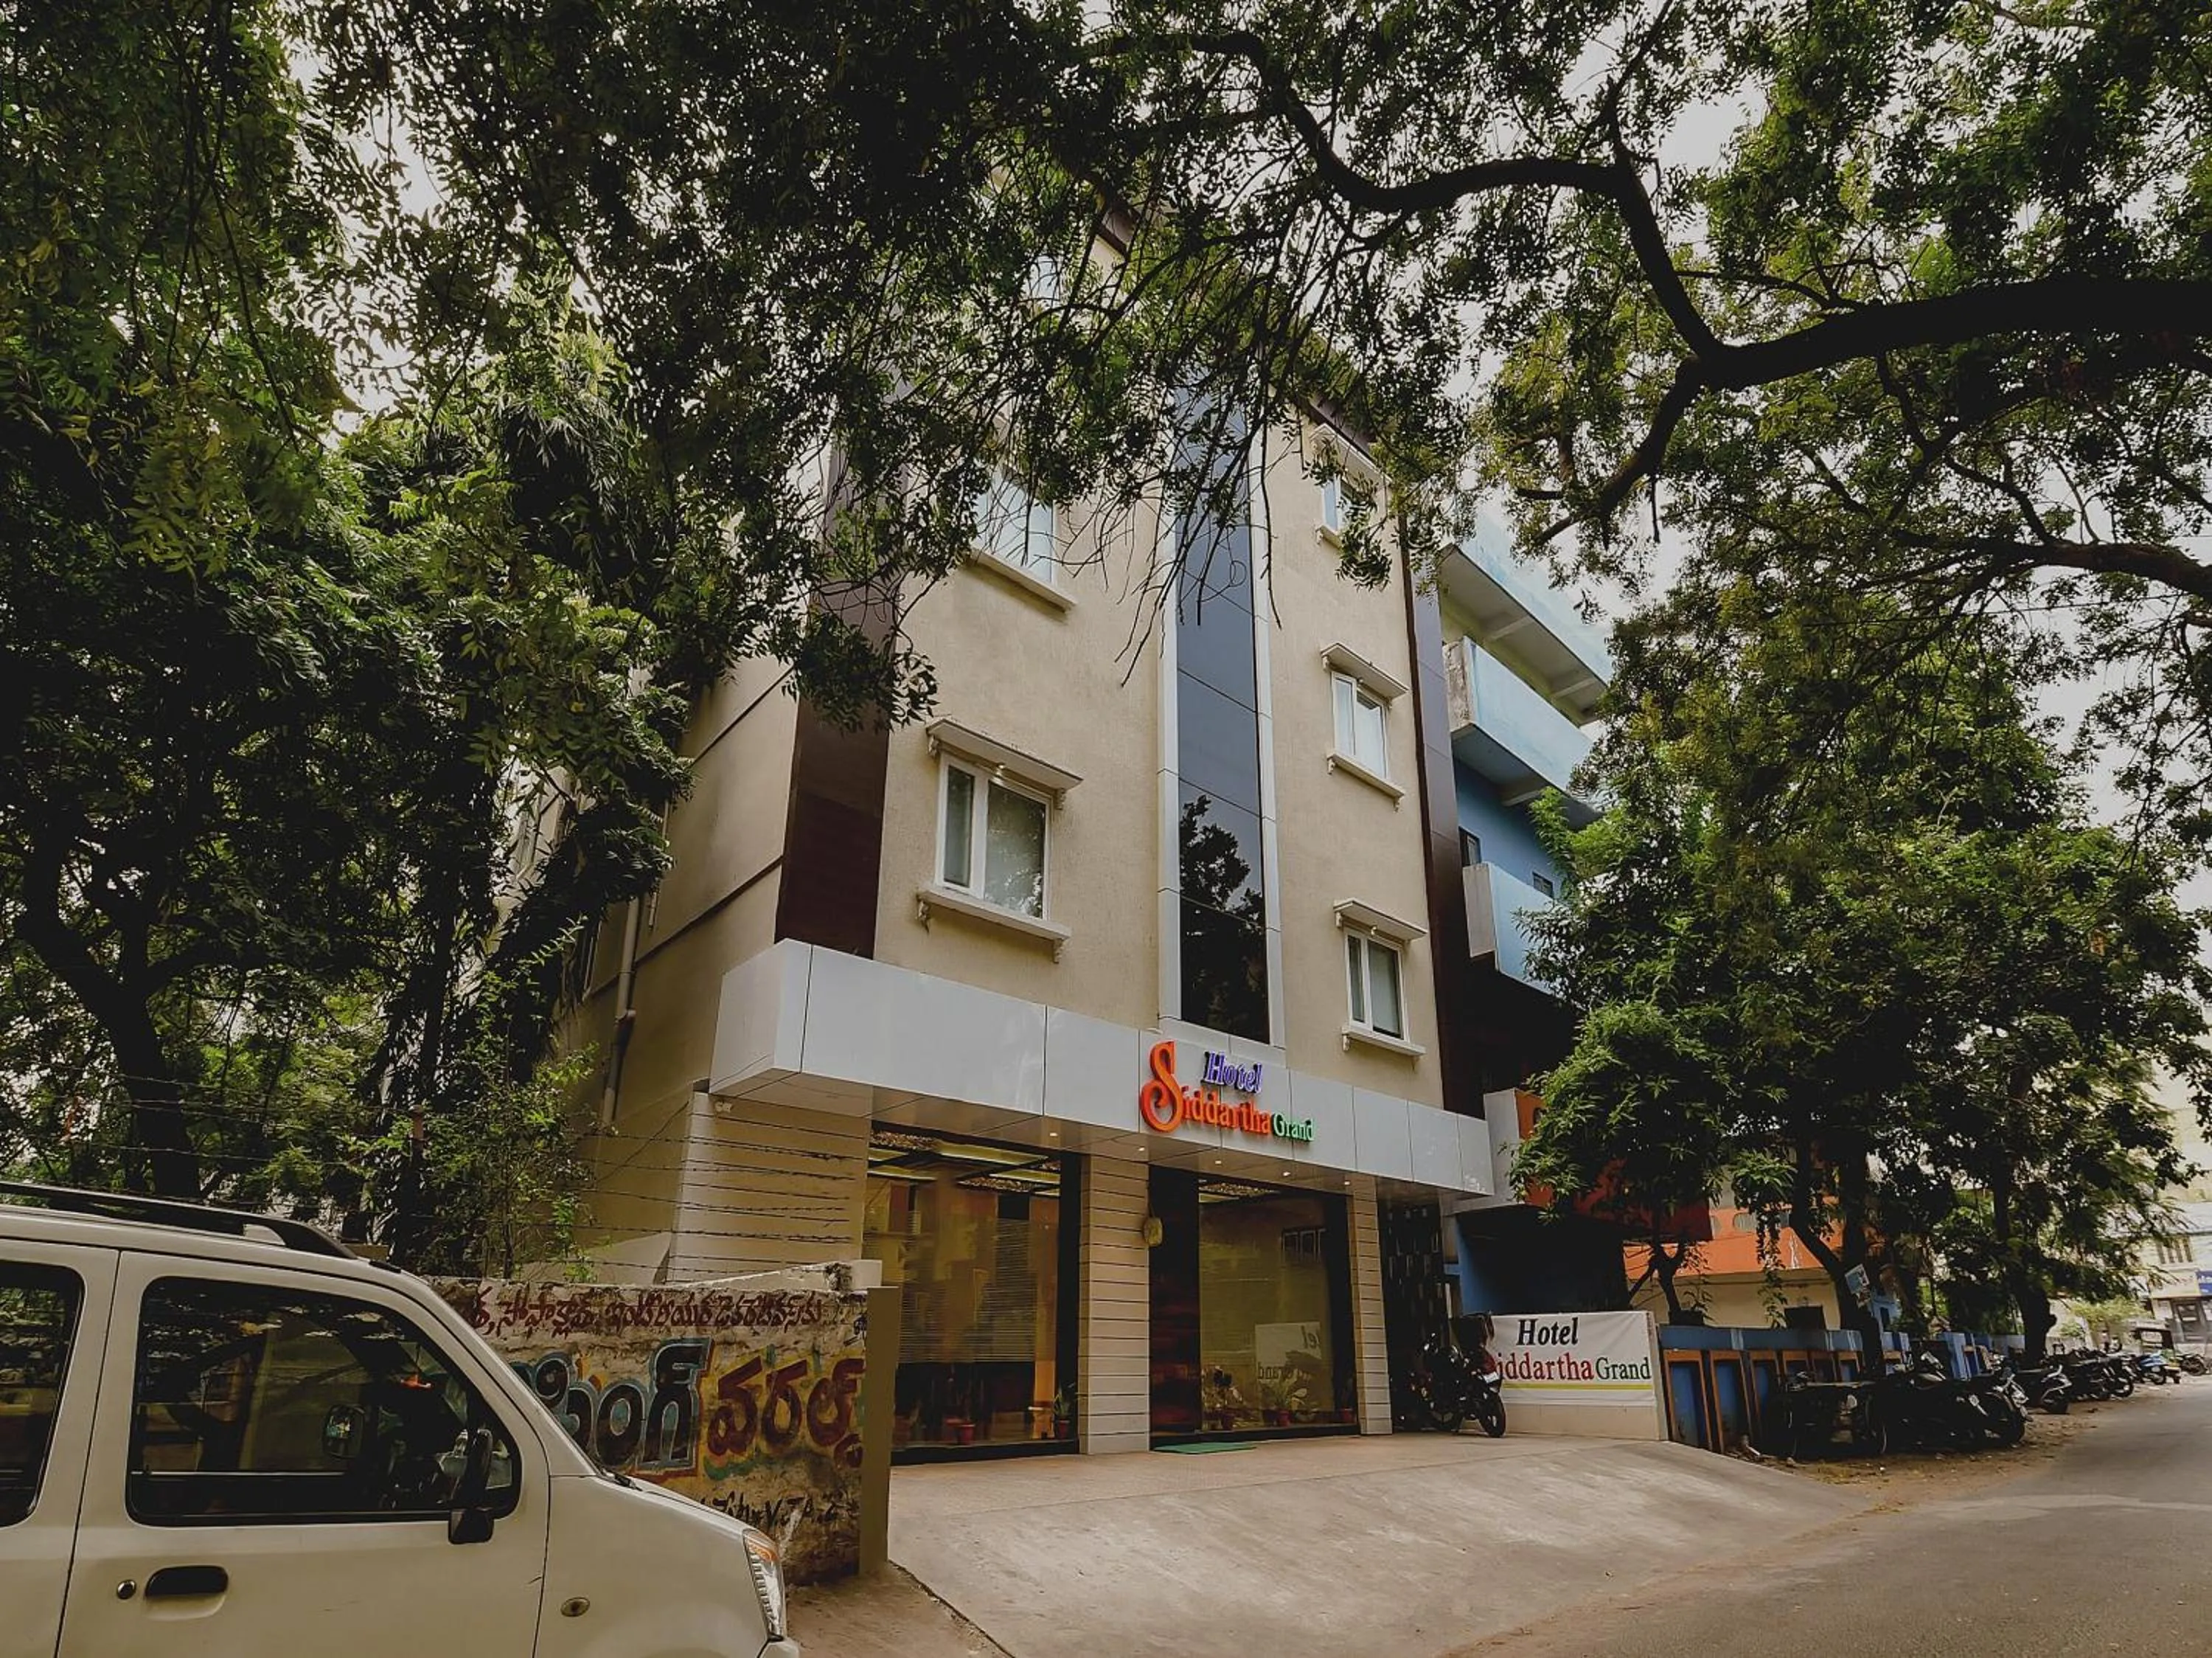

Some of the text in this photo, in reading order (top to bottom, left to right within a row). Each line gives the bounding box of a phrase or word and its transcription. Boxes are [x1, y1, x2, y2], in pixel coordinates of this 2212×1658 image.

[1139, 1038, 1315, 1142] Siddartha Grand
[1201, 1050, 1262, 1094] Hotel
[1517, 1317, 1579, 1346] Hotel
[1496, 1351, 1594, 1381] iddartha
[1596, 1356, 1652, 1380] Grand
